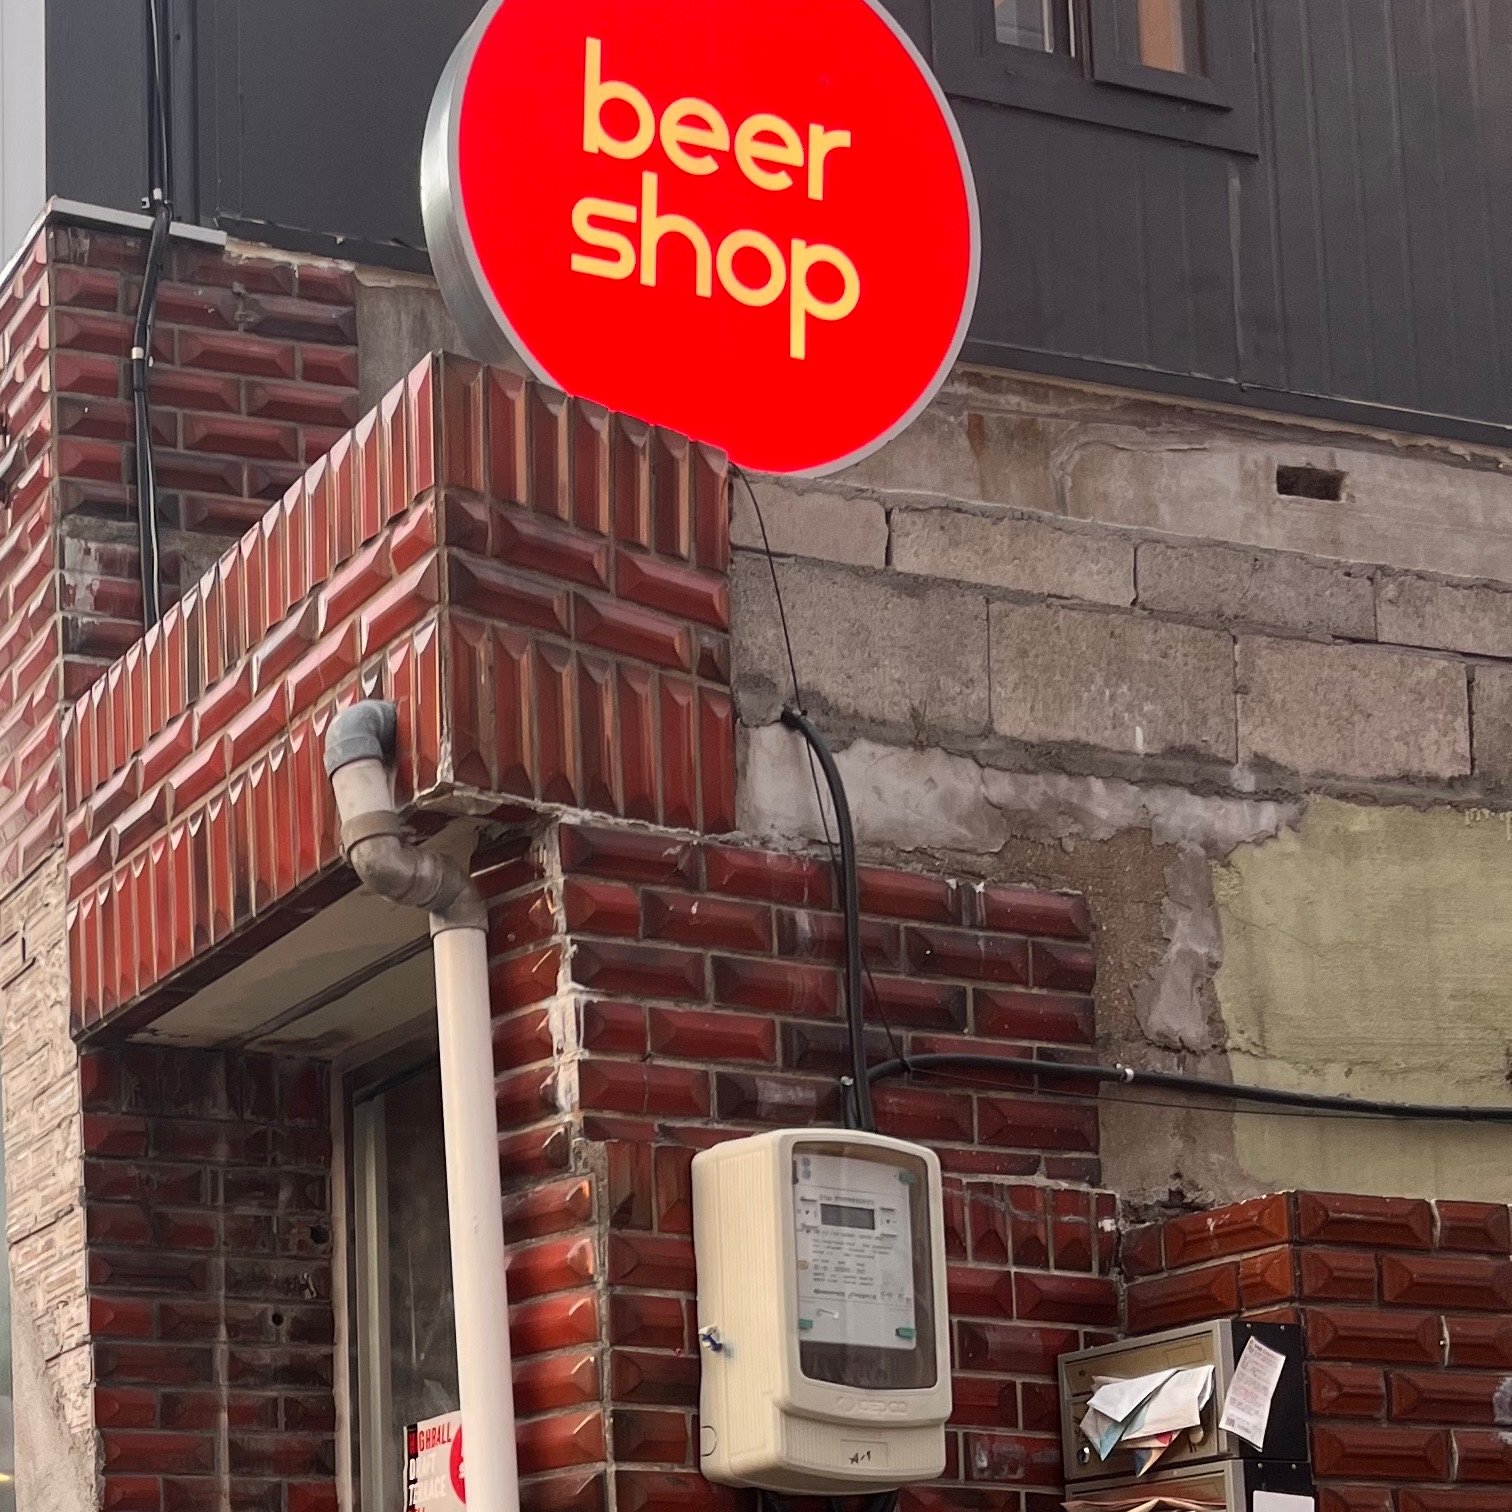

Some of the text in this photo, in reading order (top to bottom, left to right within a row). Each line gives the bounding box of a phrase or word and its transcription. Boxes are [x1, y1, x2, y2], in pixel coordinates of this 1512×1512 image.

[583, 36, 851, 202] beer
[571, 171, 860, 360] shop
[408, 1474, 447, 1506] TERRACE
